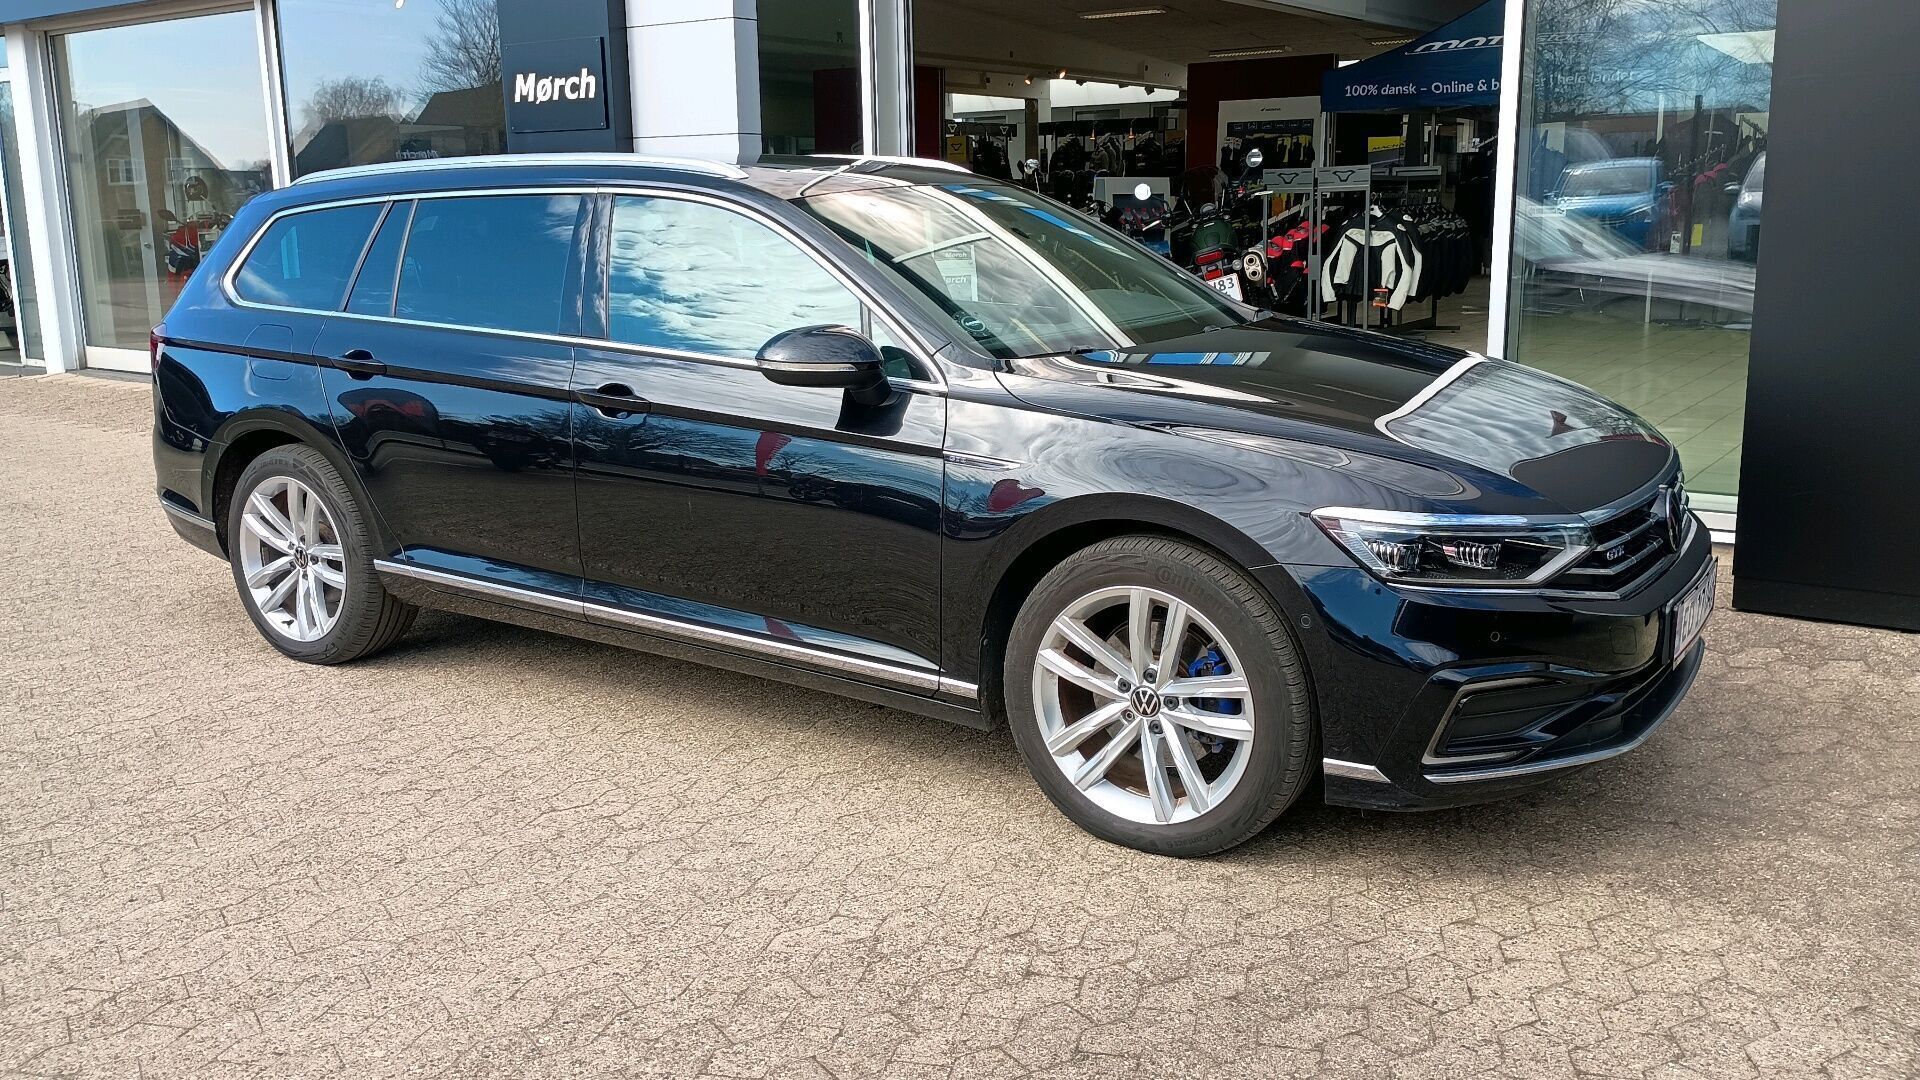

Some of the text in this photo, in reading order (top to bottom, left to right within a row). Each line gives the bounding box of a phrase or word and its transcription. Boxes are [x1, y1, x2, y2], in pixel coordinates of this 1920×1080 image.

[514, 67, 596, 105] Mørch
[1345, 84, 1378, 97] 100%
[1381, 83, 1417, 95] dansk
[1431, 80, 1474, 94] Online
[1477, 79, 1488, 92] &
[1557, 73, 1587, 85] hele
